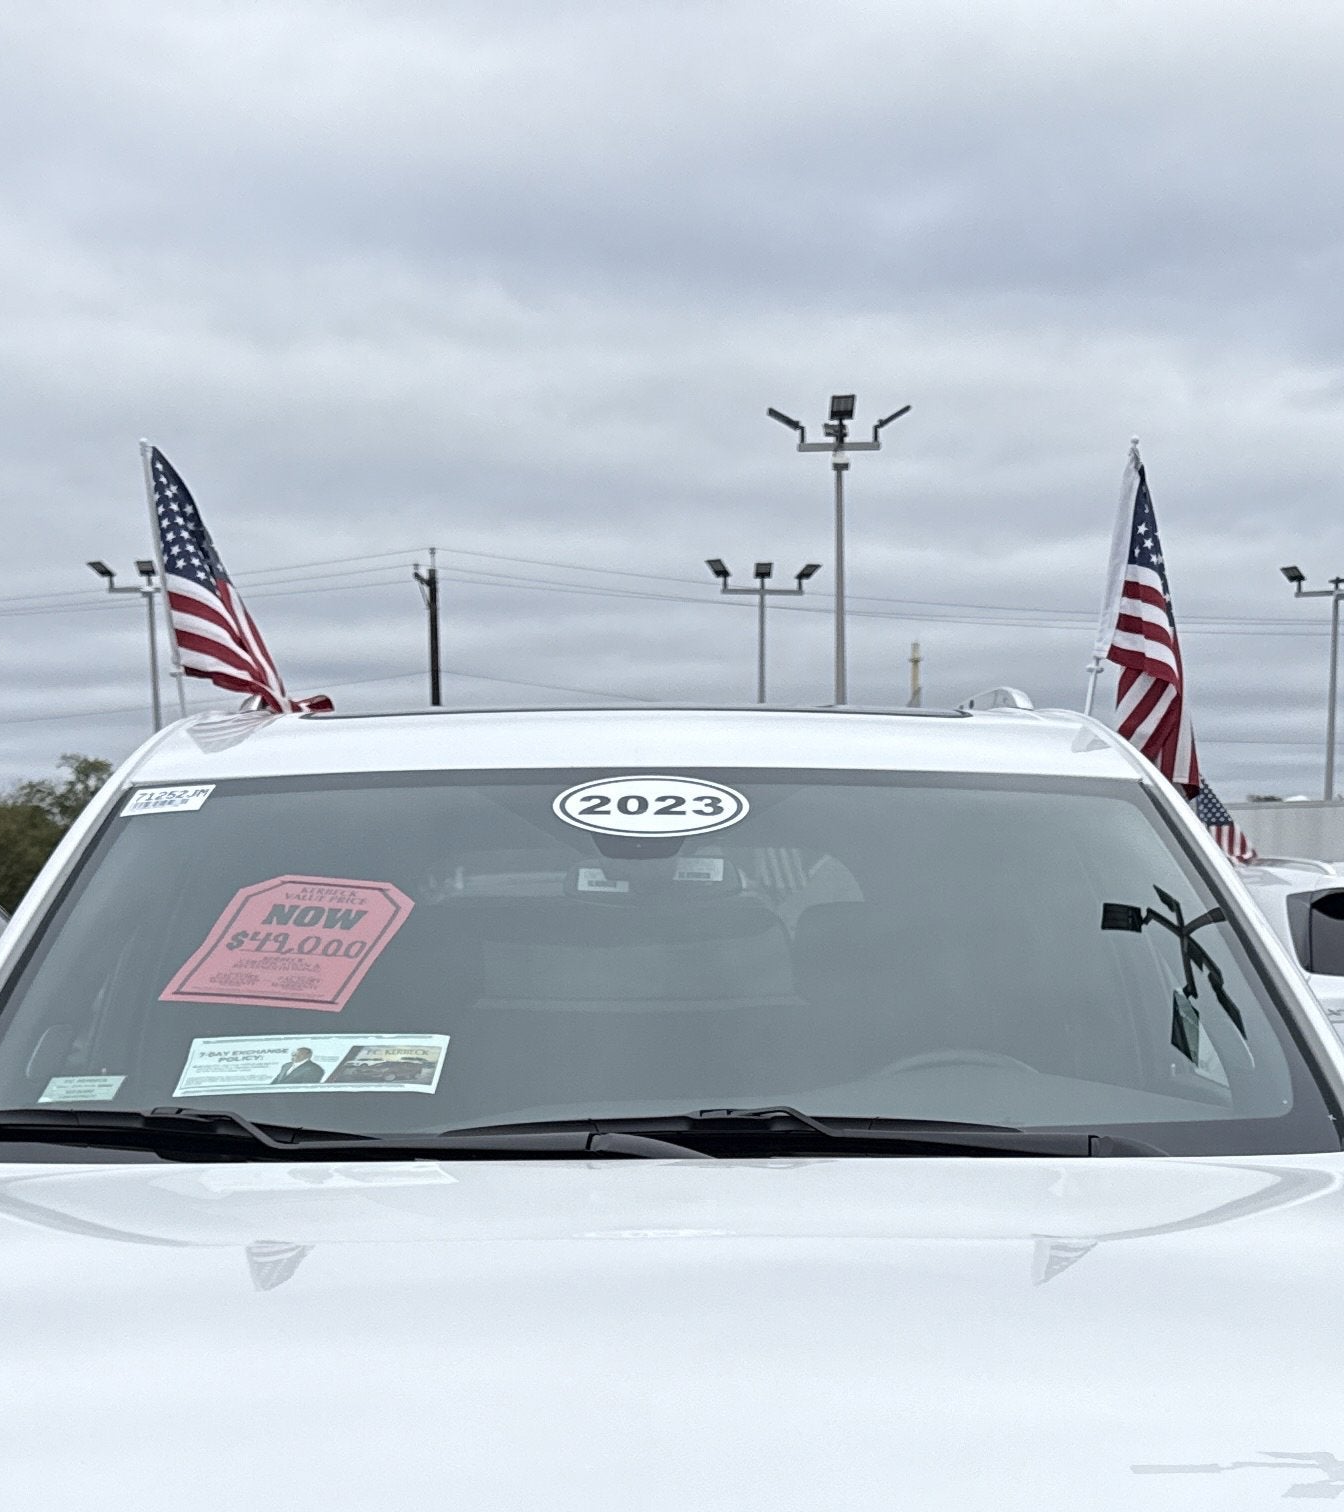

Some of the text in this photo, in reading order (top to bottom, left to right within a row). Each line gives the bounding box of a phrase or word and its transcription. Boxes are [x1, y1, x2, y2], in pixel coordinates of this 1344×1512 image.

[136, 788, 210, 802] 71252JM
[577, 795, 725, 817] 2023
[284, 892, 369, 906] VALUE PRICE
[261, 903, 369, 930] NOW
[232, 1047, 290, 1056] EXCHANGE
